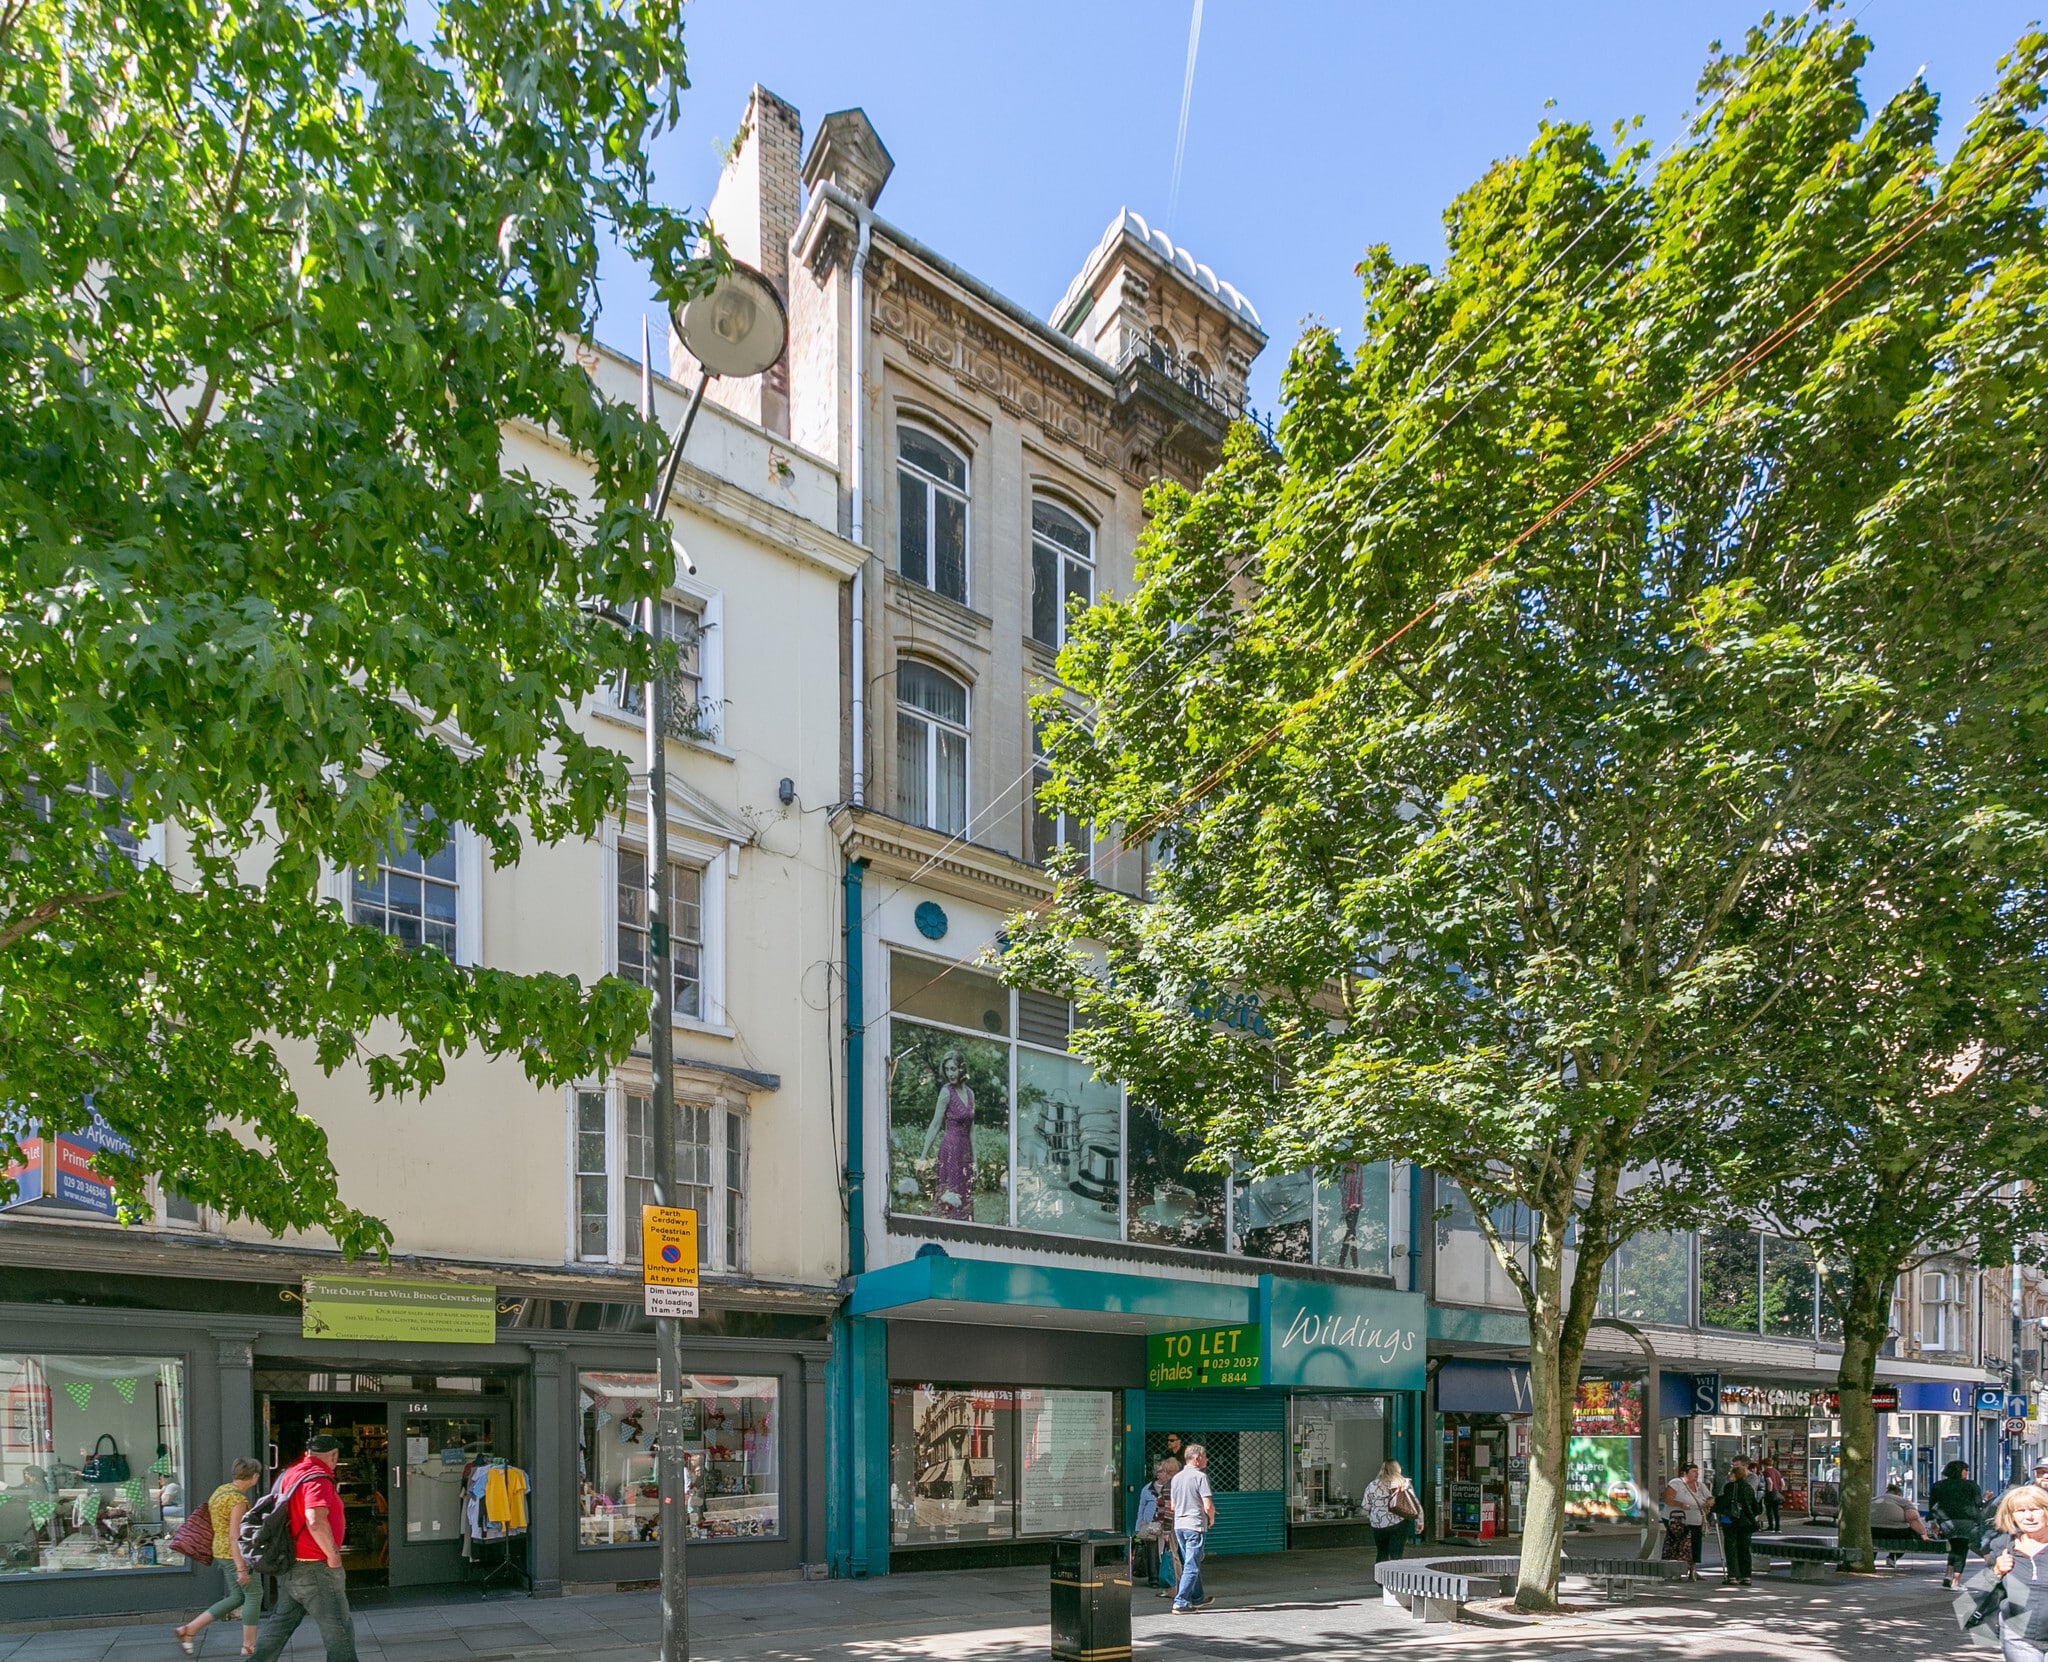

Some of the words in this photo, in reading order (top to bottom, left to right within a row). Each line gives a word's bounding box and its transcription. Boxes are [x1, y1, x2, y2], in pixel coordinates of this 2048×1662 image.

[63, 1175, 76, 1189] 029
[76, 1179, 86, 1192] 20
[85, 1182, 107, 1200] 346346
[660, 1209, 681, 1218] Parth
[651, 1216, 689, 1227] Cerddwyr
[650, 1226, 691, 1237] Pedestrian
[661, 1234, 681, 1243] Zone
[647, 1264, 677, 1273] Unrhyw
[678, 1267, 696, 1275] bryd
[650, 1274, 660, 1282] At
[661, 1276, 675, 1284] any
[676, 1276, 694, 1285] time
[649, 1287, 665, 1295] Dim
[666, 1288, 695, 1297] llwytho
[652, 1297, 663, 1305] No
[665, 1298, 693, 1308] loading
[1281, 1305, 1416, 1364] Wildings
[1164, 1335, 1192, 1359] TO
[1200, 1329, 1242, 1356] LET
[1150, 1362, 1193, 1387] ejhales
[1211, 1357, 1231, 1370] 029
[1232, 1356, 1259, 1369] 2037
[1220, 1371, 1248, 1384] 8844
[1697, 1376, 1715, 1386] WH
[1695, 1385, 1715, 1413] S
[1766, 1388, 1811, 1407] COMICS
[409, 1403, 428, 1413] 164
[2008, 1421, 2023, 1429] 20
[1576, 1462, 1604, 1472] there
[1571, 1472, 1588, 1482] the
[1452, 1484, 1479, 1493] Gaming
